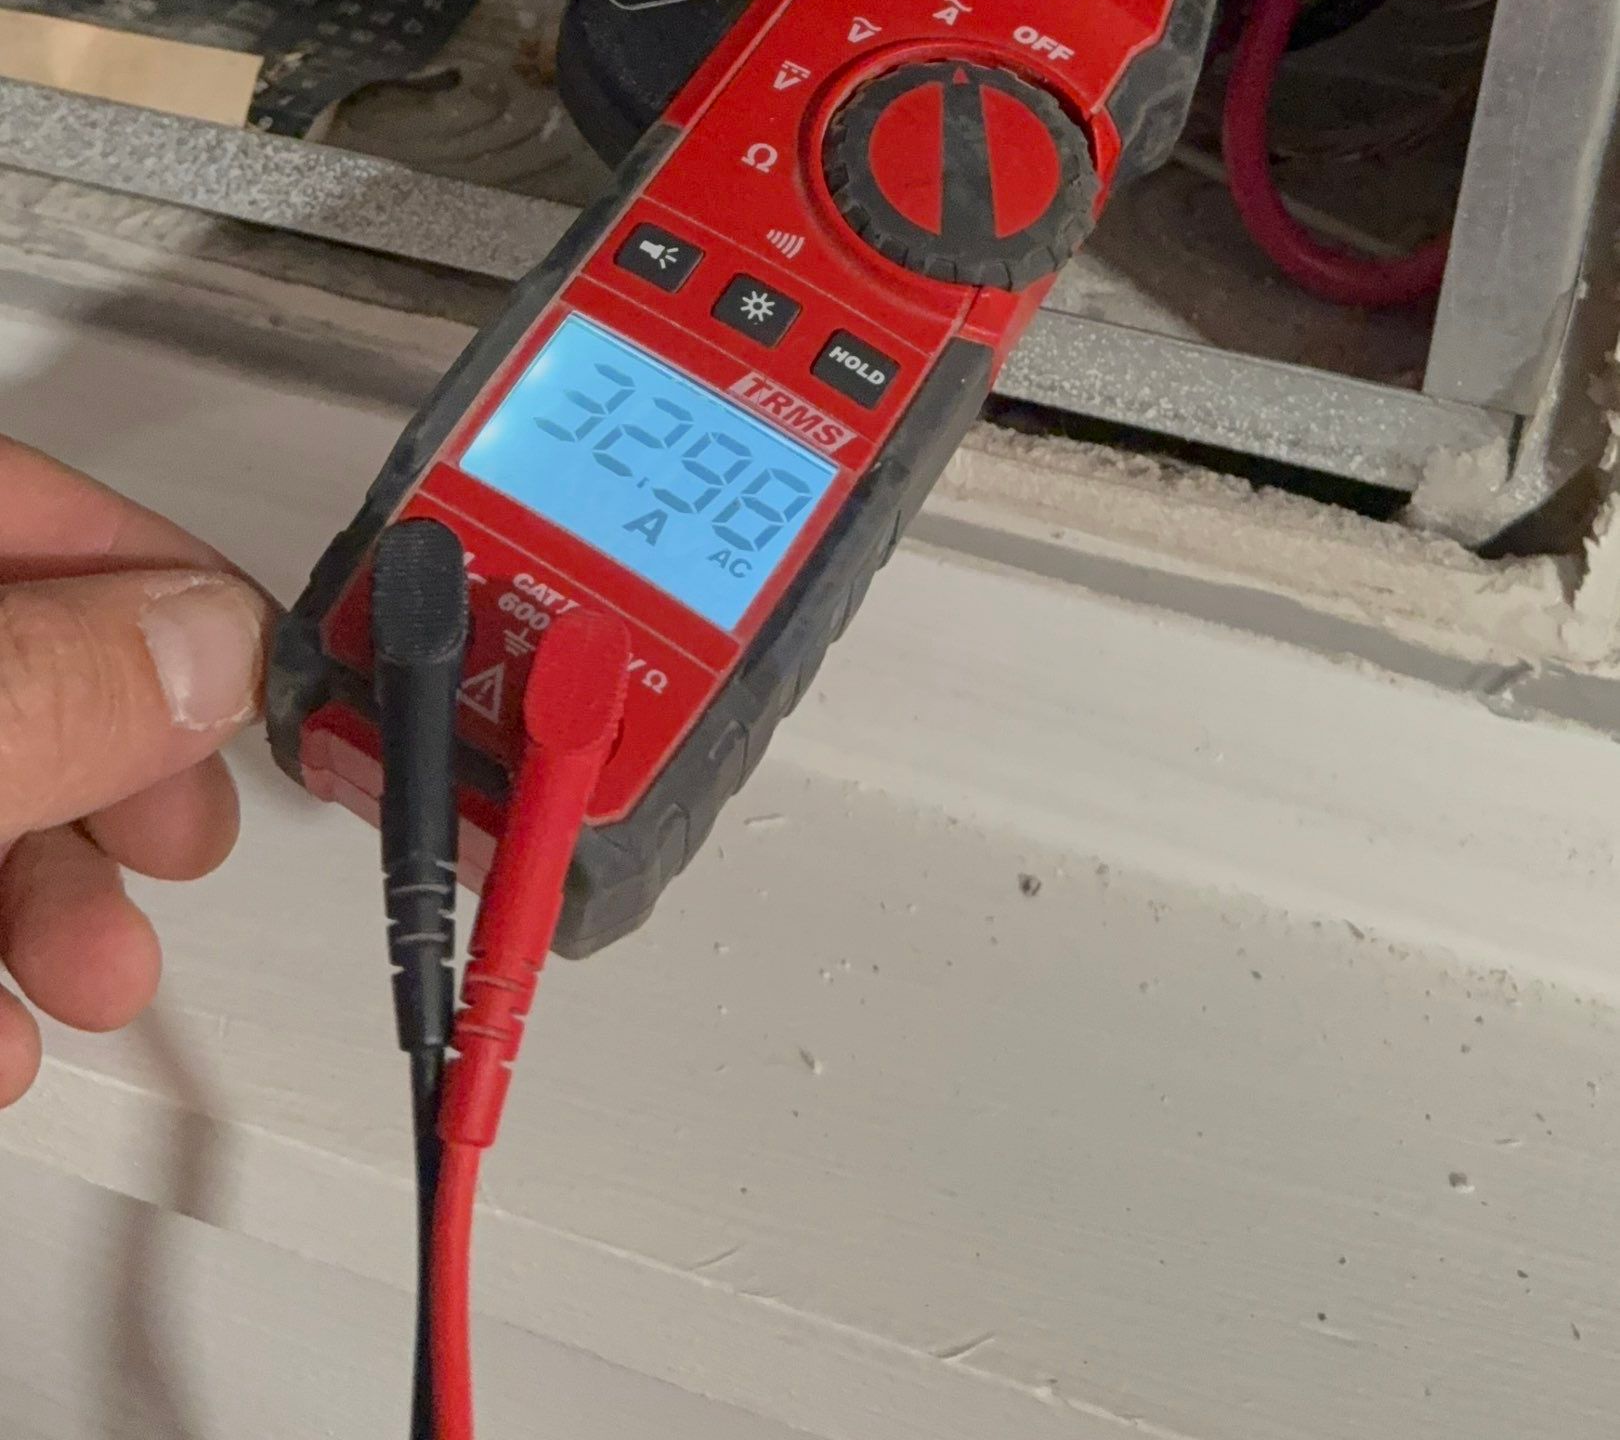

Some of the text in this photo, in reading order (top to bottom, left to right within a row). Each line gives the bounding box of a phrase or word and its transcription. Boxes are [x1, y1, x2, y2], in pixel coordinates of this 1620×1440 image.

[1012, 25, 1075, 61] OFF
[828, 345, 886, 387] HOLD
[742, 376, 846, 447] TRMS
[623, 508, 669, 546] A
[707, 548, 753, 580] AC
